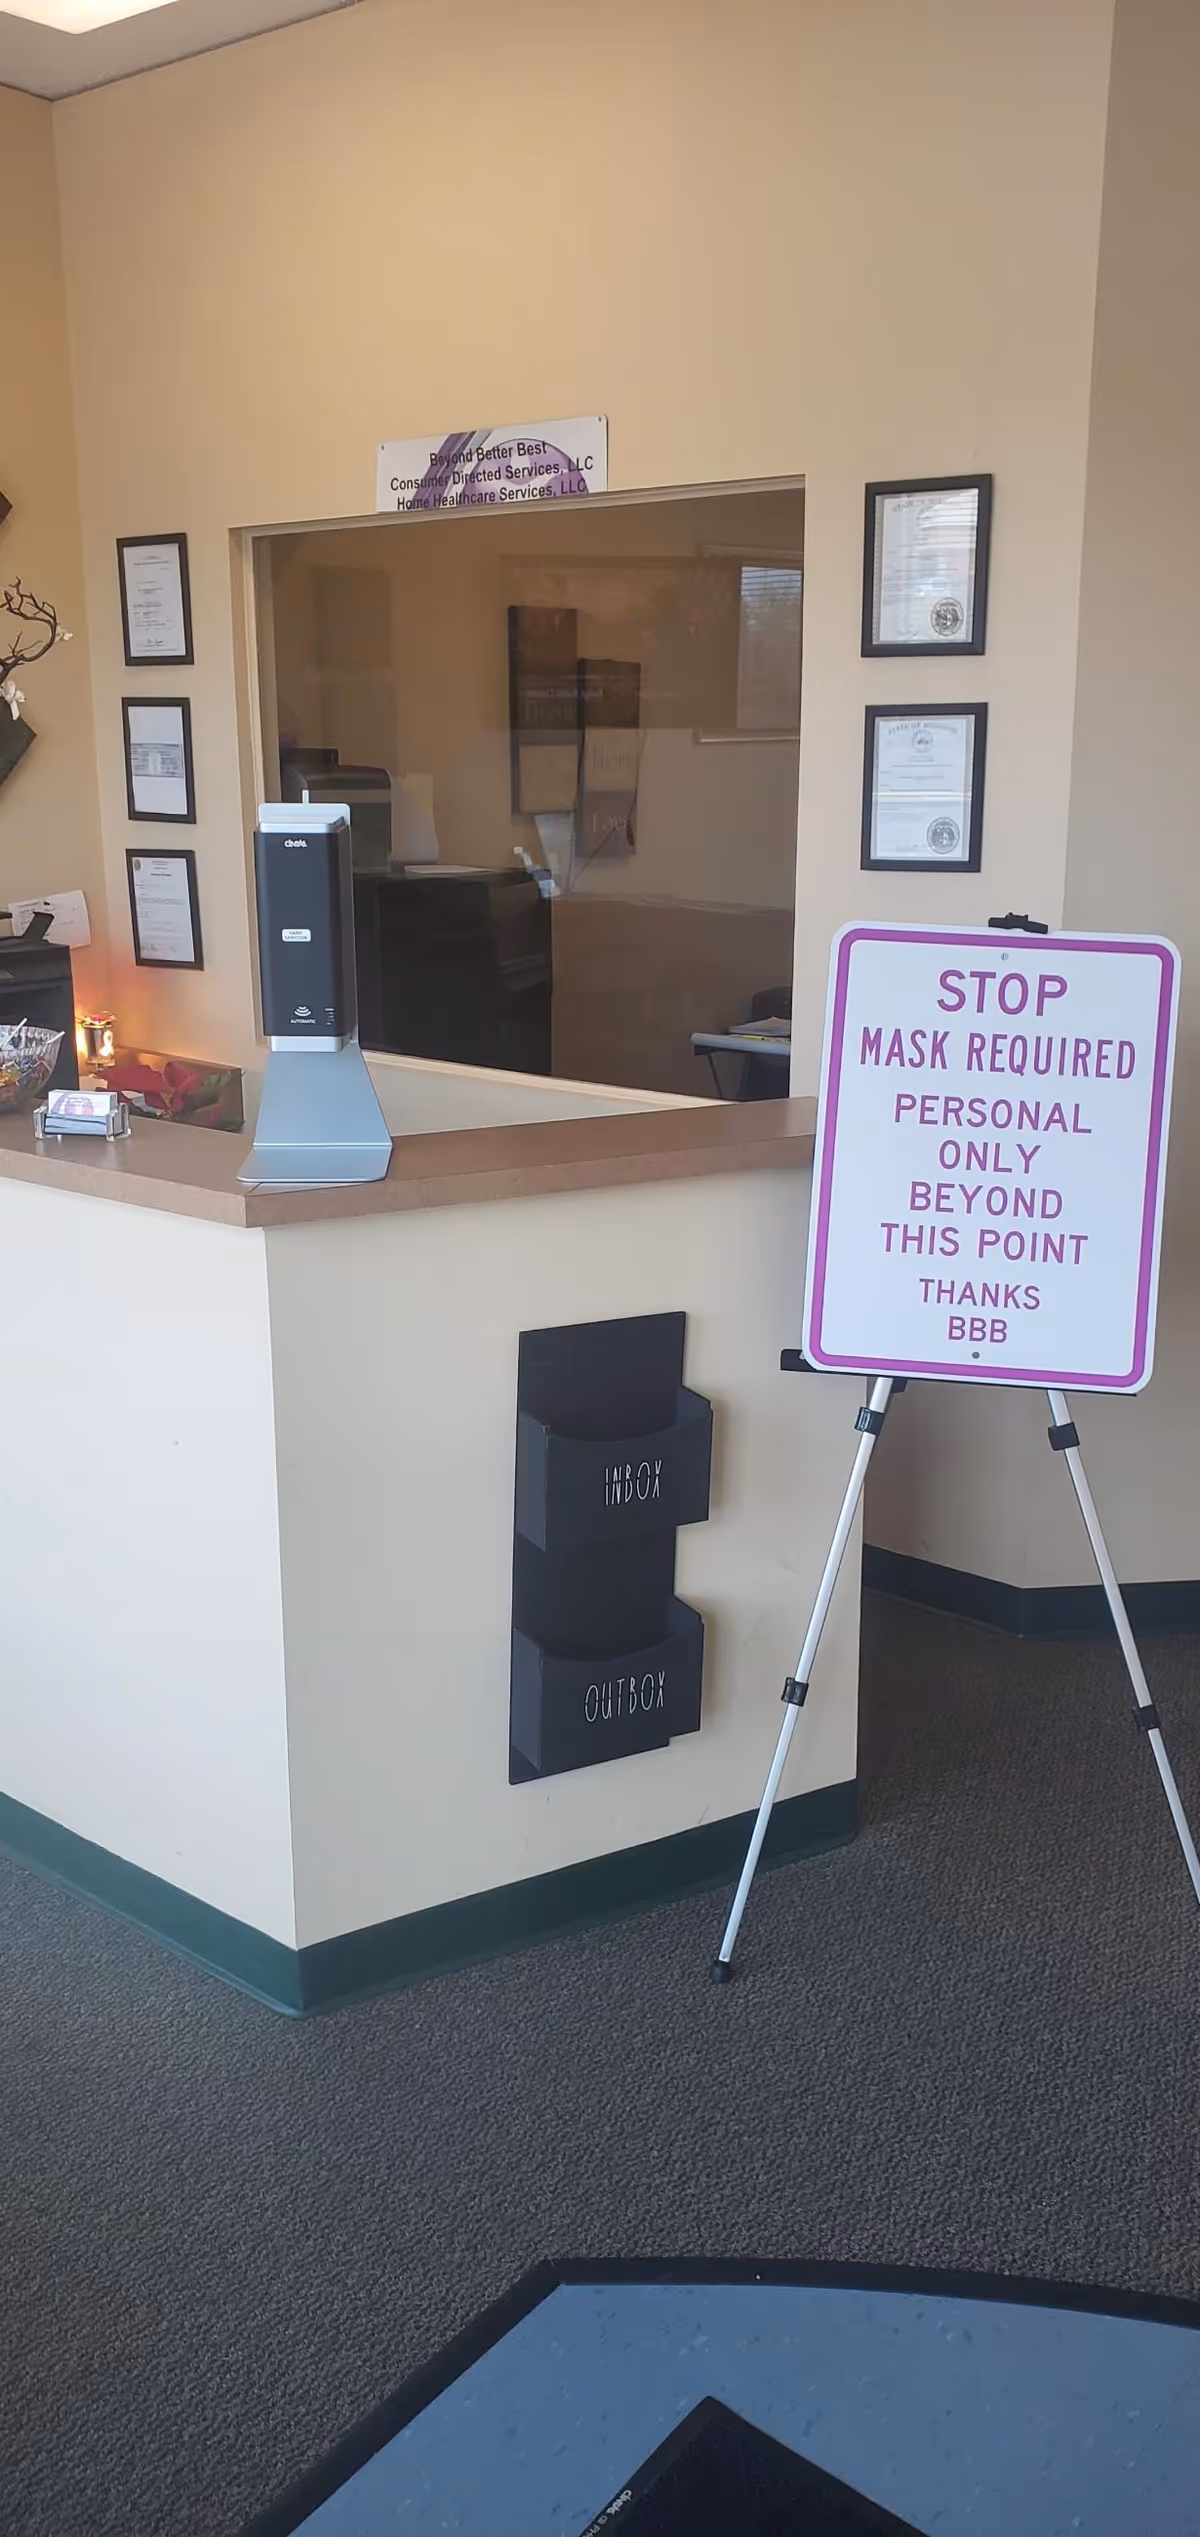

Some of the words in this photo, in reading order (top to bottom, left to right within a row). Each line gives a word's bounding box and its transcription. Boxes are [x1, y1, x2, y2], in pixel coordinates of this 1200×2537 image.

[390, 474, 450, 491] Consumer
[452, 467, 501, 485] Directed
[505, 462, 564, 479] Services,
[568, 455, 593, 472] LLC
[430, 448, 473, 468] Beyond
[476, 446, 513, 461] Better
[516, 440, 547, 457] Best
[397, 496, 430, 511] Home
[433, 490, 496, 508] Healthcare
[499, 484, 556, 501] Services,
[560, 477, 586, 495] LLC
[937, 968, 1069, 1017] STOP
[860, 1026, 950, 1070] MASK
[966, 1032, 1136, 1080] REQUIRED
[894, 1093, 1092, 1134] PERSONAL
[938, 1139, 1041, 1174] ONLY
[909, 1181, 1063, 1219] BEYOND
[881, 1222, 960, 1257] THIS
[978, 1229, 1089, 1265] POINT
[919, 1278, 1041, 1310] THANKS
[947, 1315, 1008, 1344] BBB
[604, 1459, 662, 1506] INBOX
[585, 1670, 666, 1723] OUTBOX
